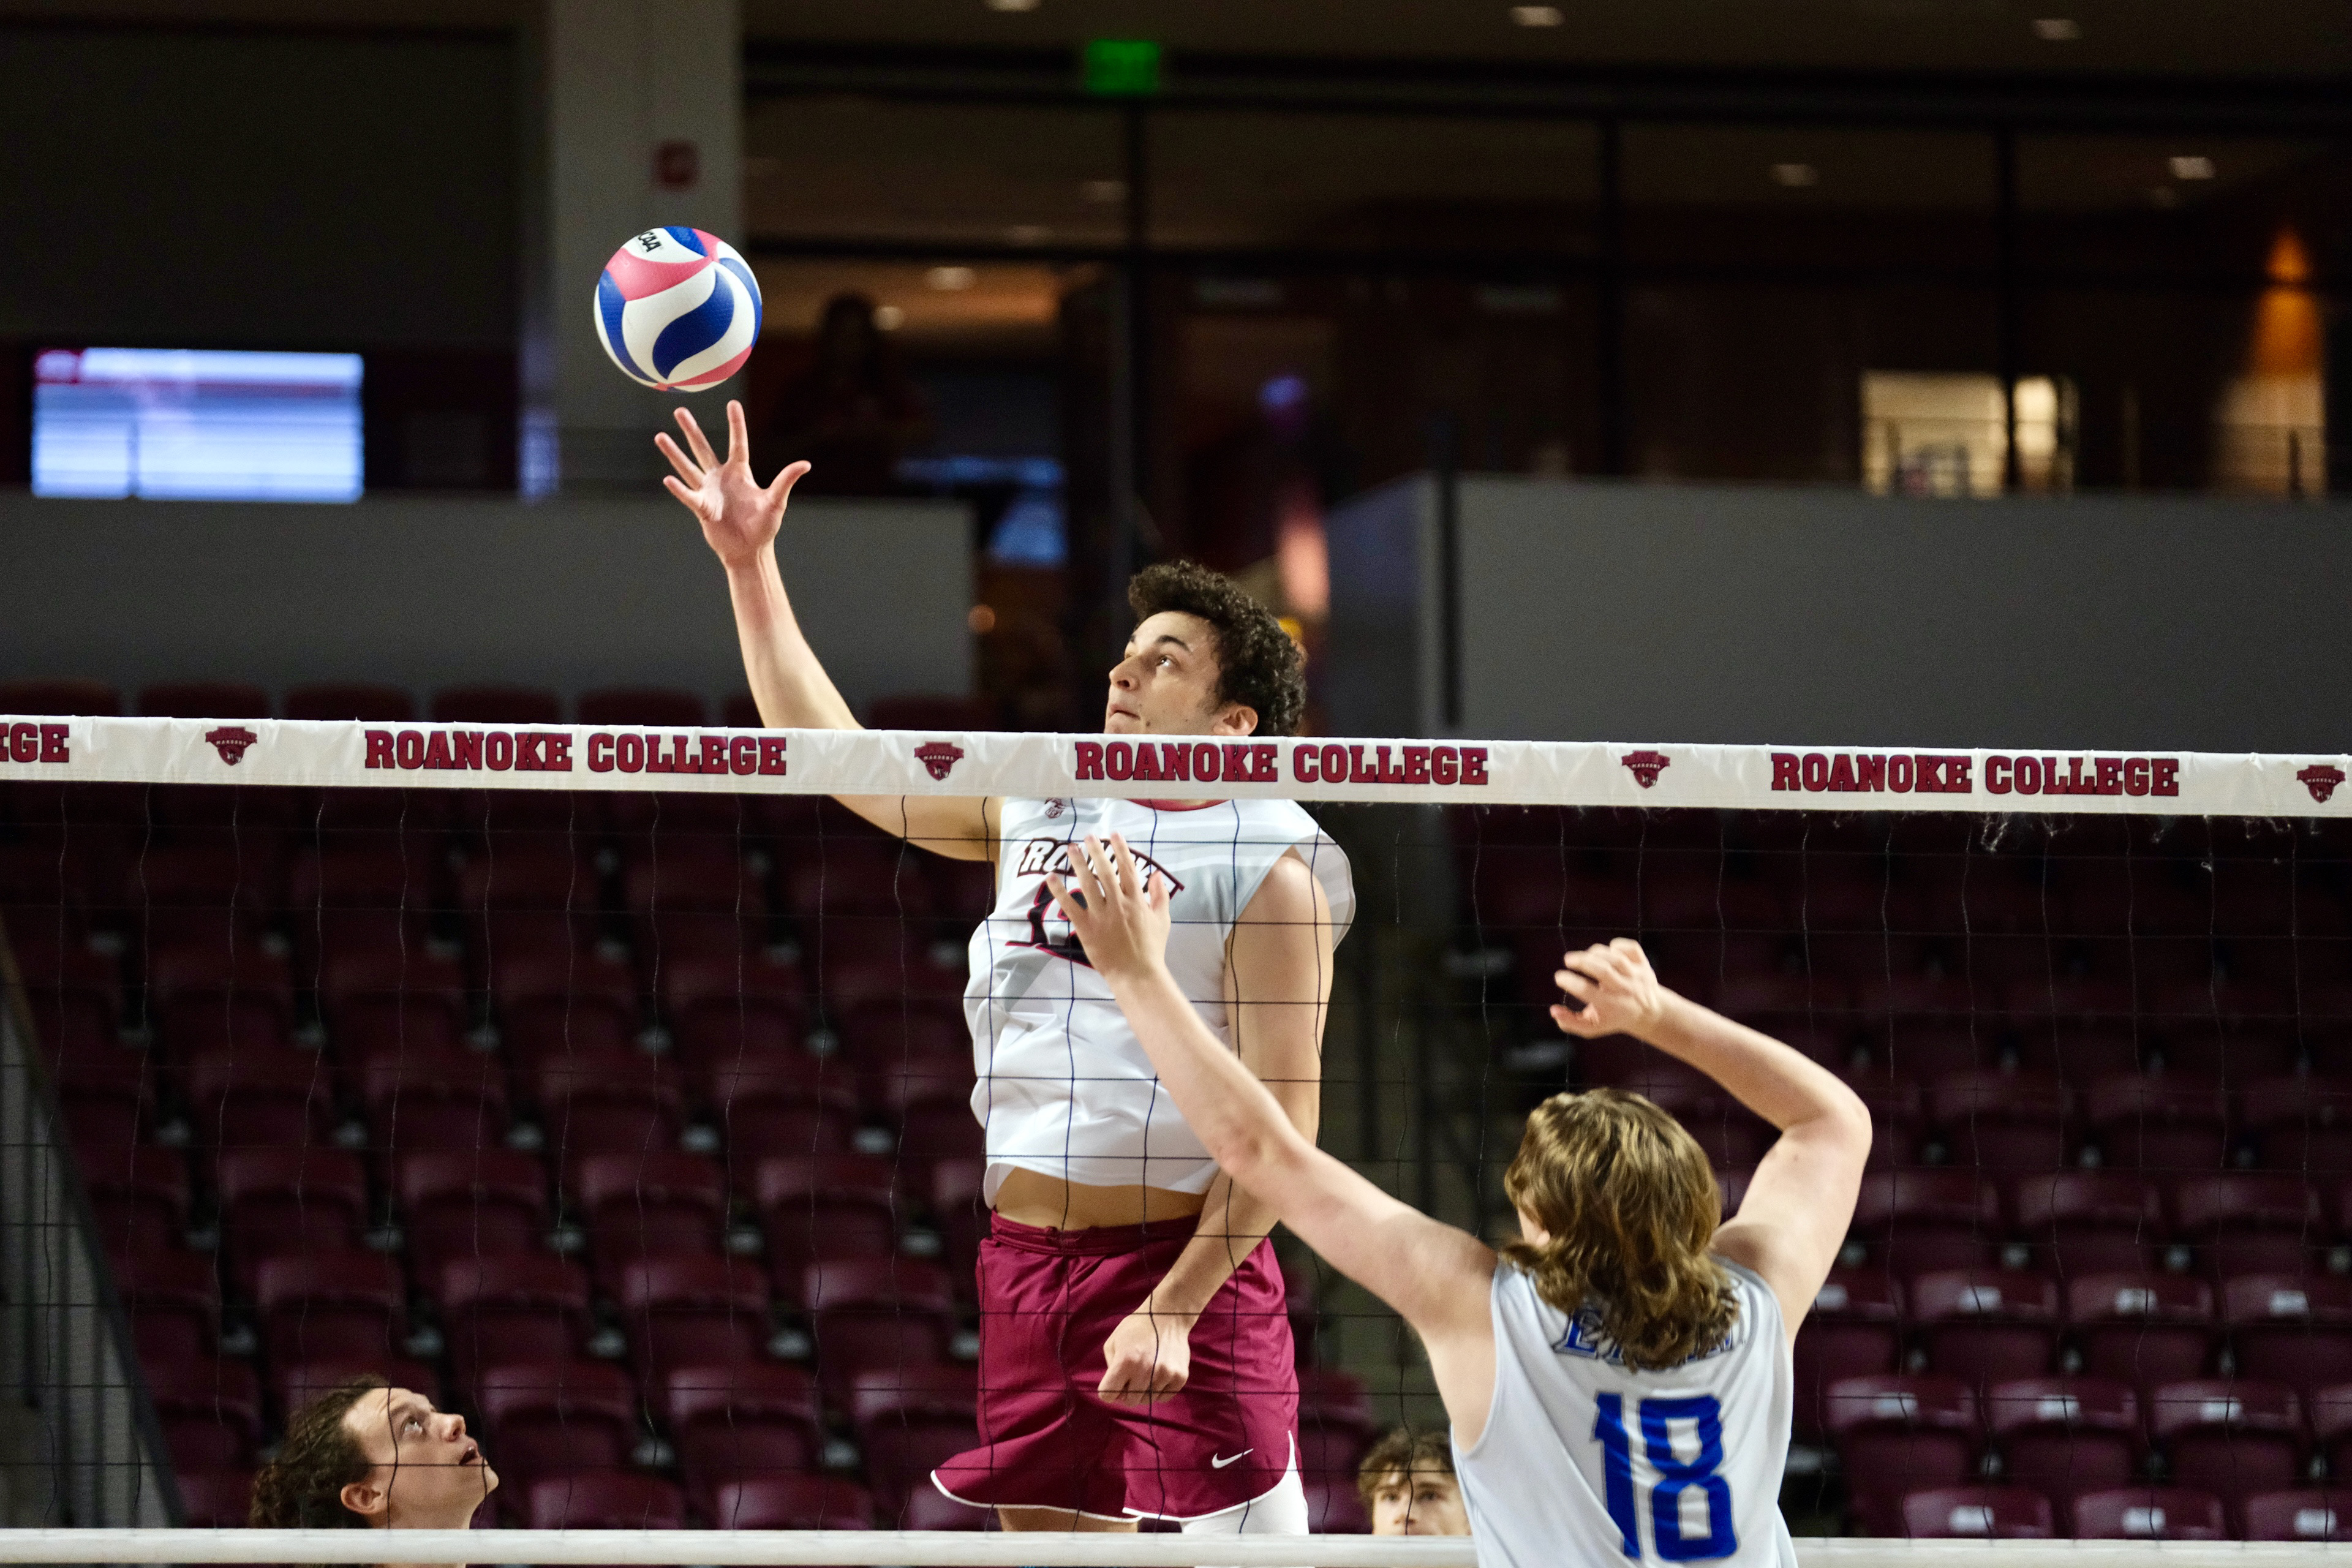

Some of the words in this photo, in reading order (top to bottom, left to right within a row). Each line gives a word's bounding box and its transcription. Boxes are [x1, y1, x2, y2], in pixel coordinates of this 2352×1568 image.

[638, 232, 662, 252] CAA
[364, 729, 573, 771] ROANOKE
[587, 733, 786, 775] COLLEGE
[1074, 741, 1278, 782] ROANOKE
[1293, 744, 1488, 785] COLLEGE
[1771, 753, 1972, 793] ROANOKE
[1985, 755, 2179, 797] COLLEGE
[1591, 1390, 1741, 1564] 18
